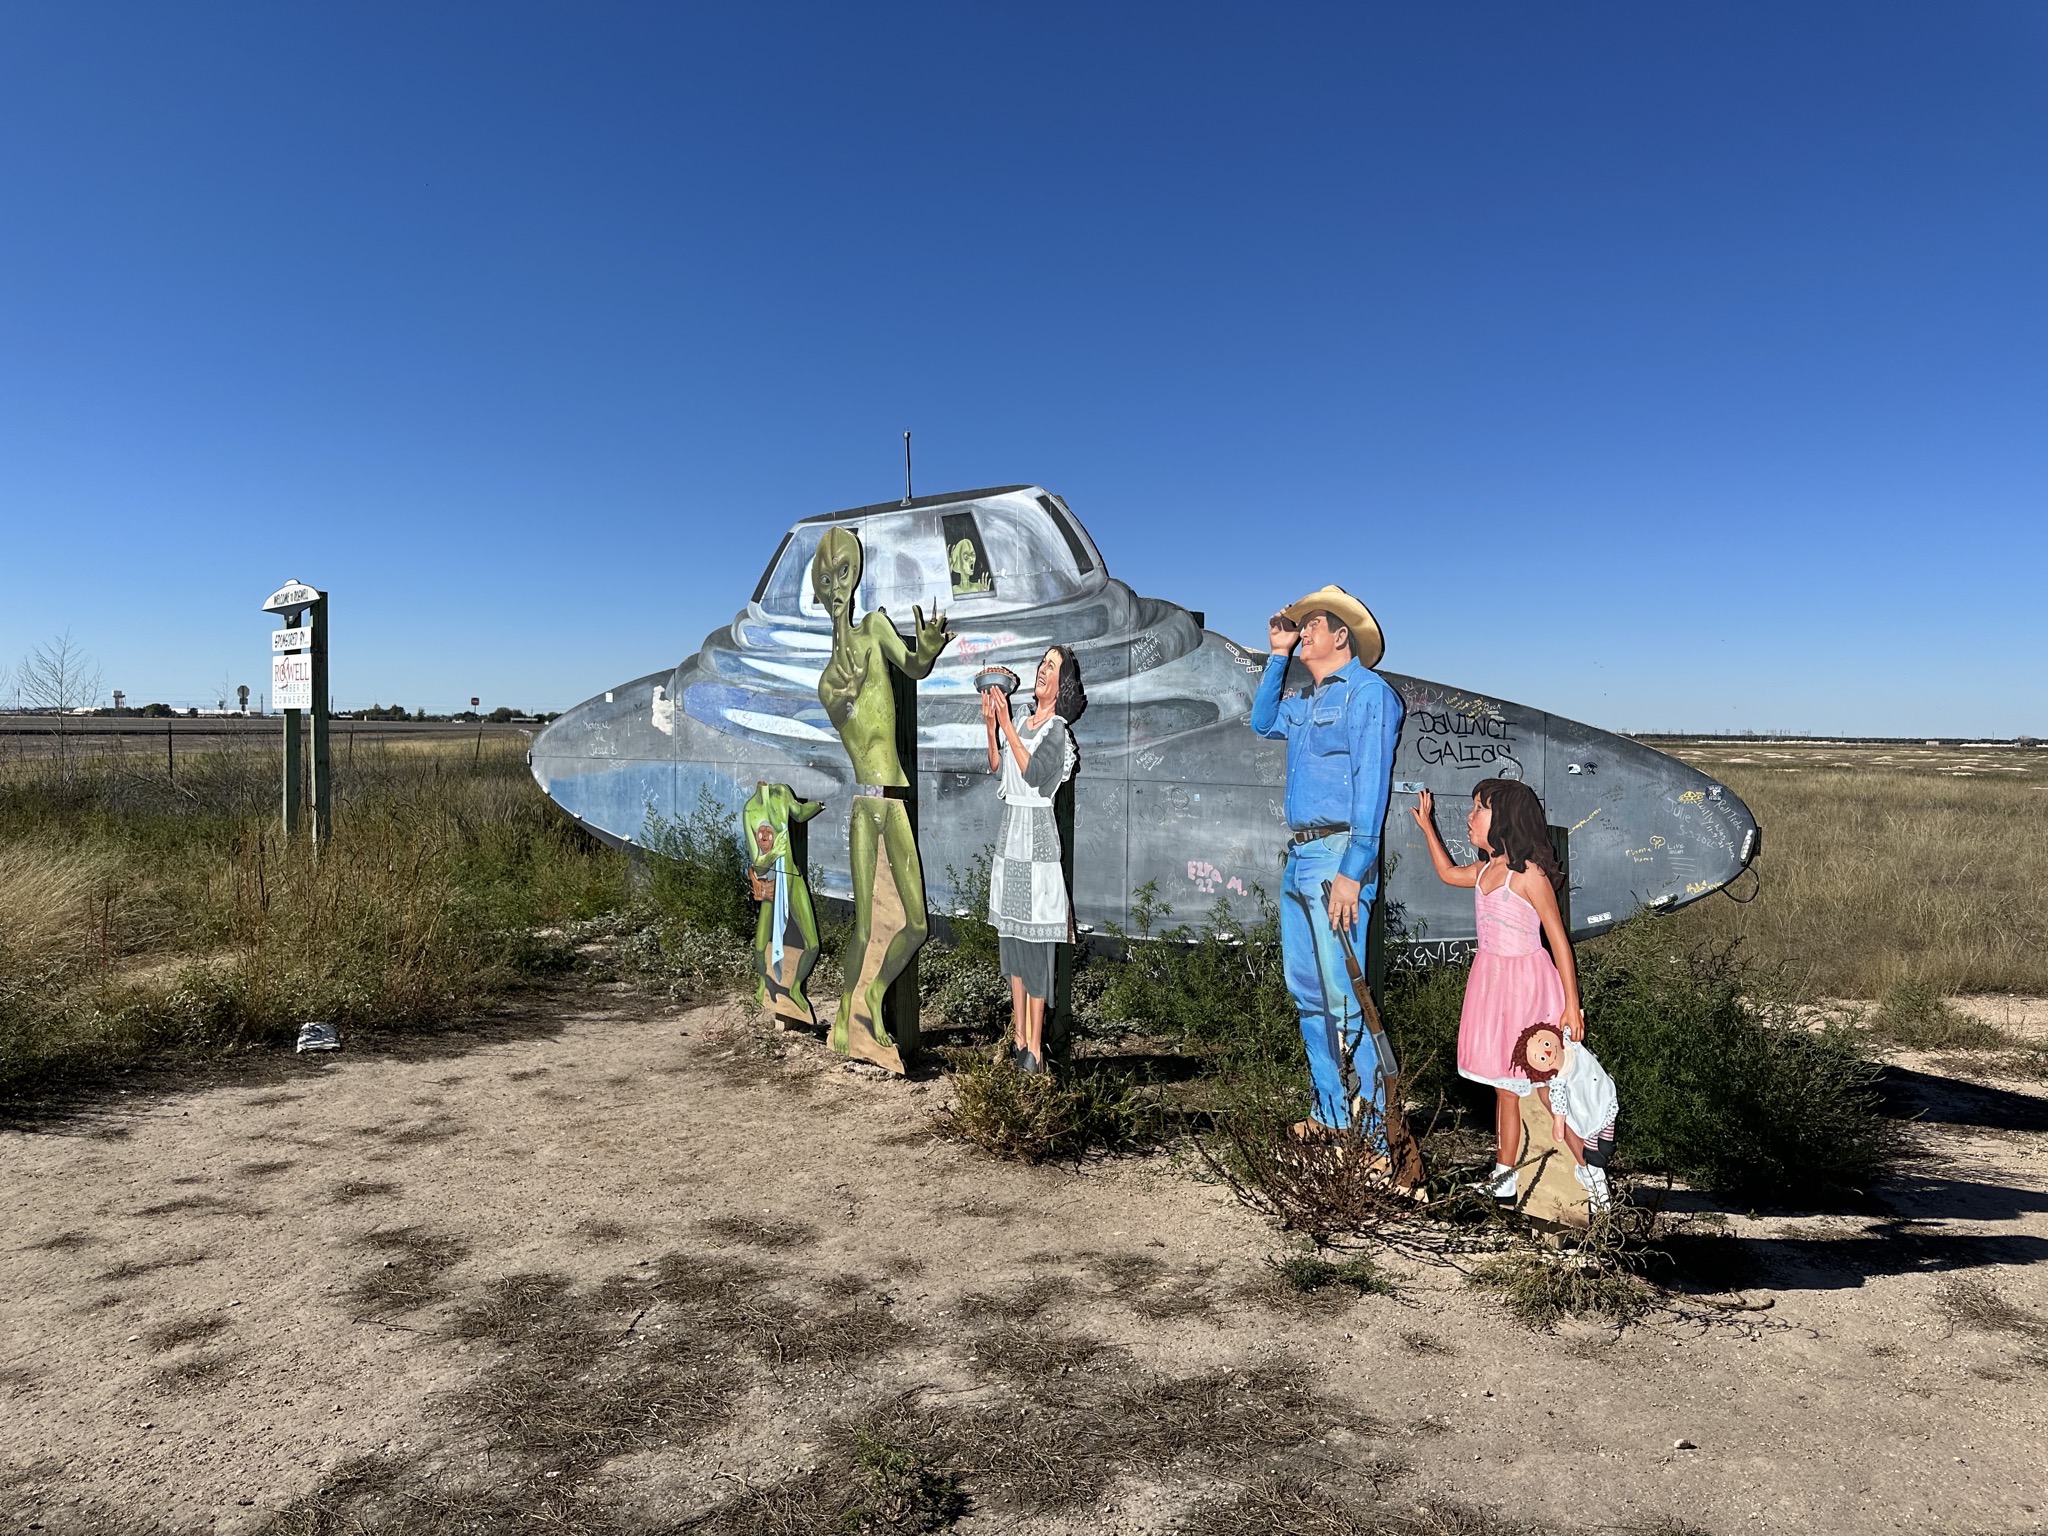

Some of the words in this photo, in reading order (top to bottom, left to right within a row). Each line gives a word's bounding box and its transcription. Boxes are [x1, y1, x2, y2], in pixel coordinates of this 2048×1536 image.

[275, 631, 298, 648] SPONSORED
[302, 683, 310, 692] OF
[275, 695, 309, 704] COMMERCE
[1663, 797, 1692, 824] Julie
[1727, 810, 1743, 831] Tide
[1196, 878, 1215, 894] 22
